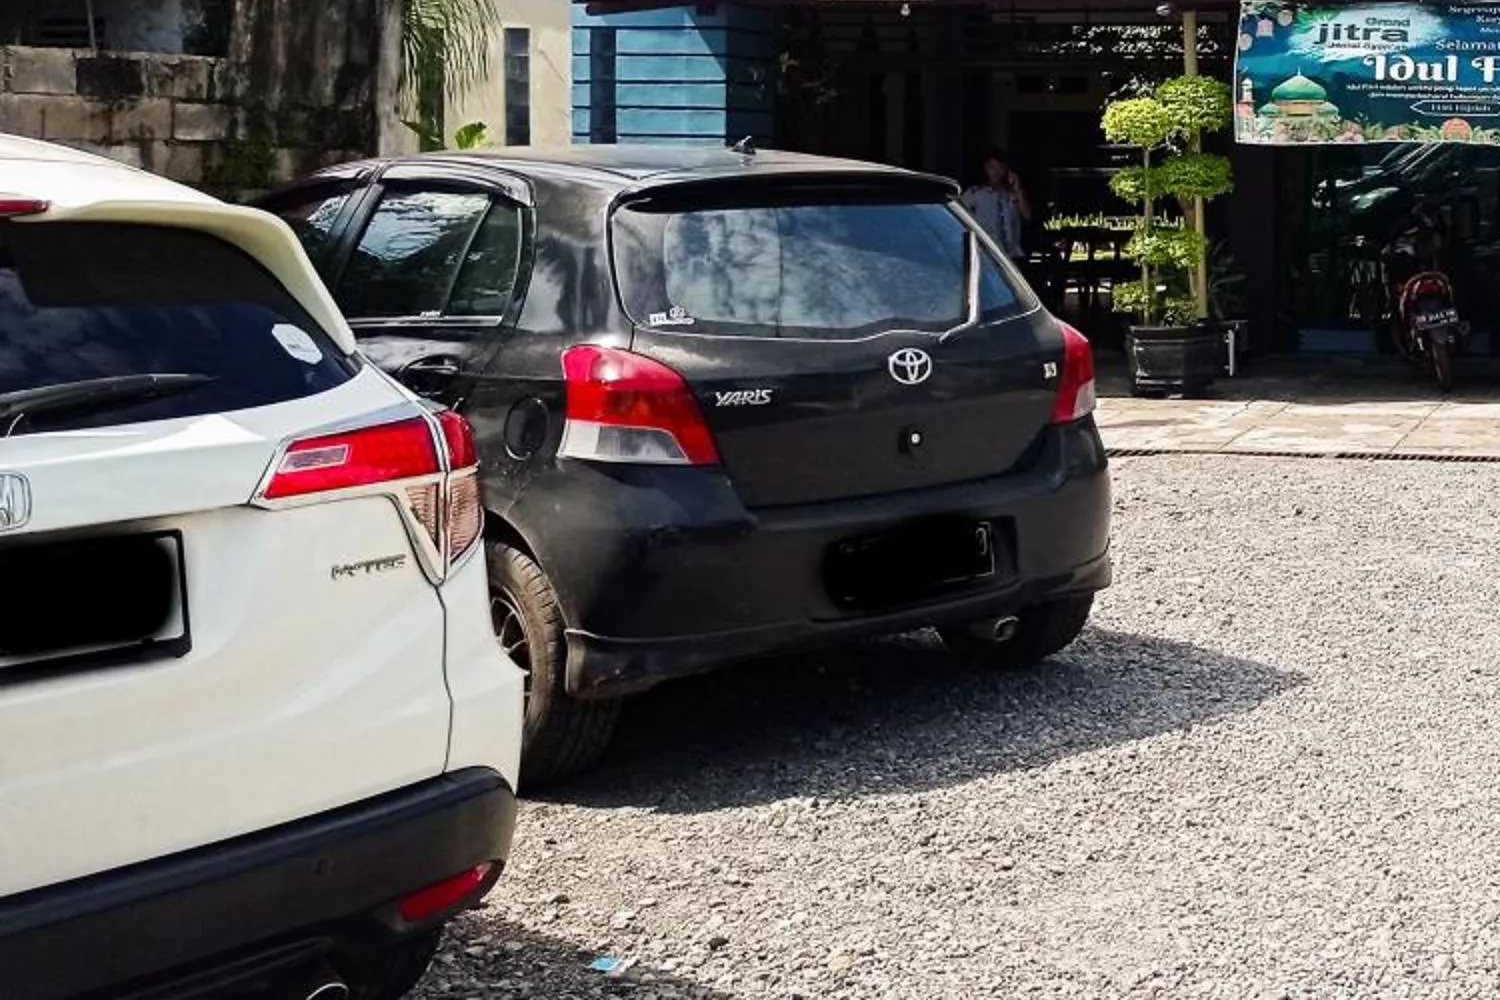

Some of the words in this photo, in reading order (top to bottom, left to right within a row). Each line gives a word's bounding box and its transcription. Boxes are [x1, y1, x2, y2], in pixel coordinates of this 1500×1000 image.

[1313, 23, 1409, 45] jitra
[1363, 54, 1458, 81] Idul
[716, 389, 773, 407] YARIS
